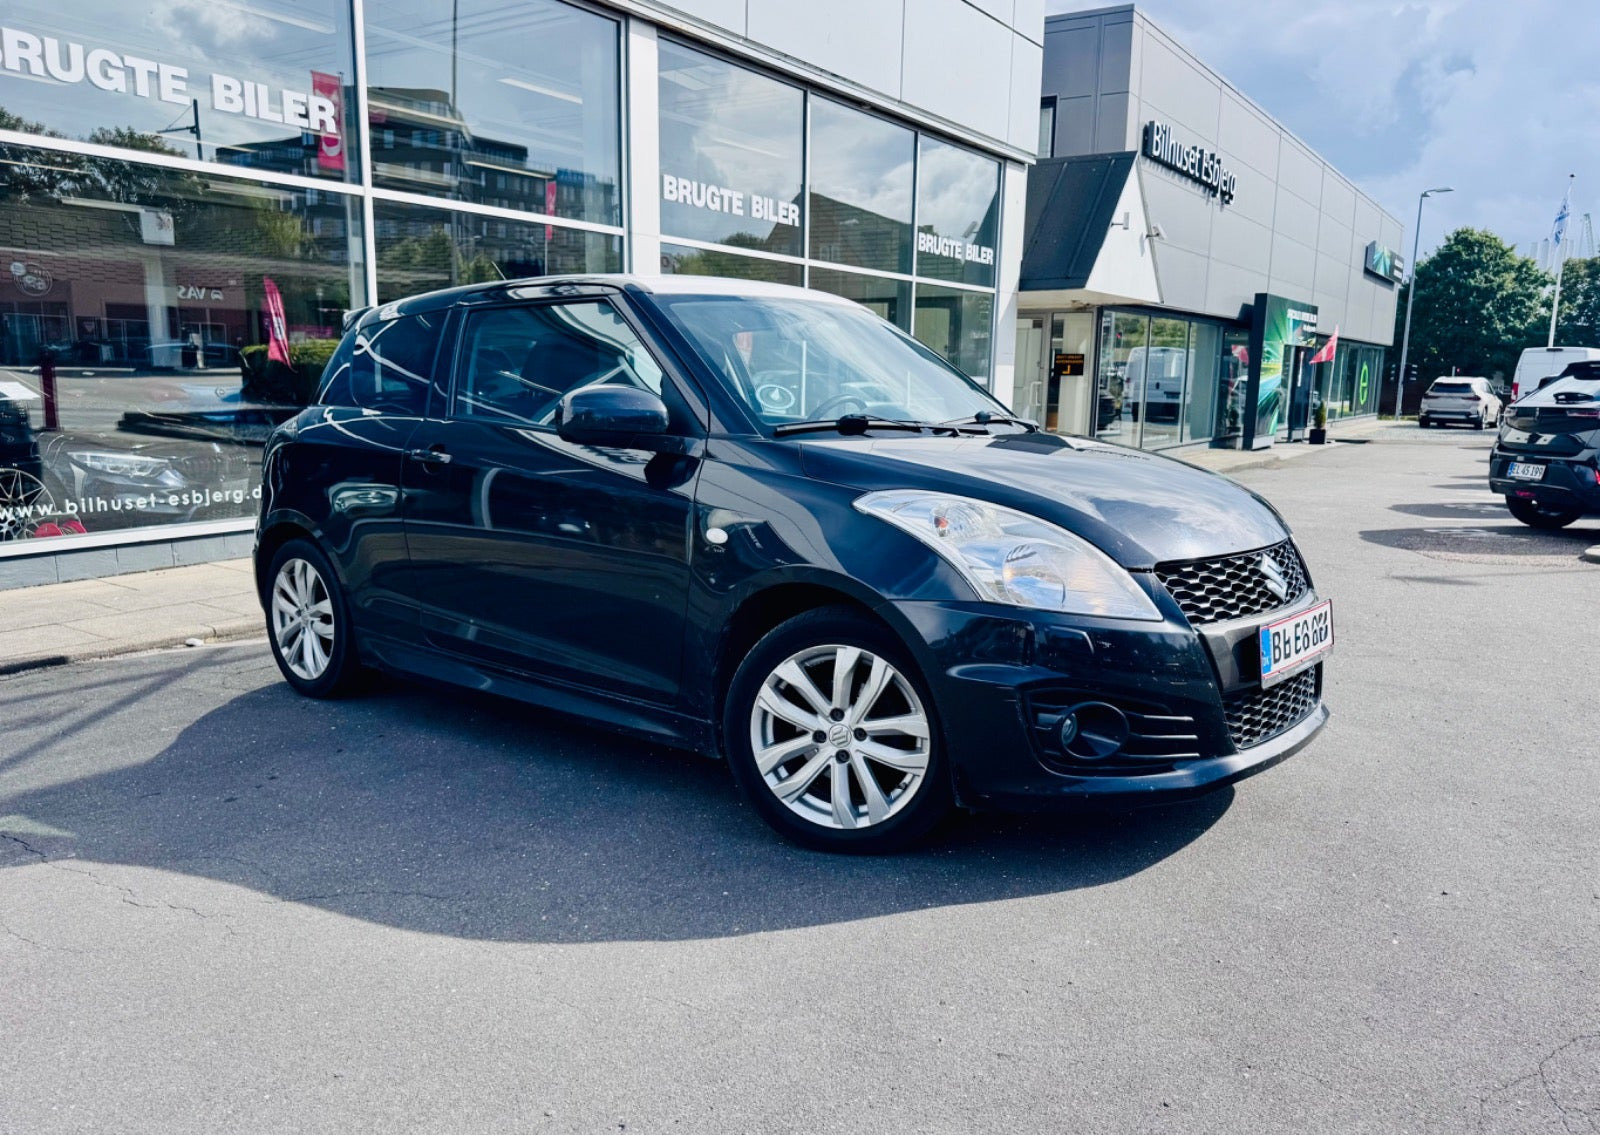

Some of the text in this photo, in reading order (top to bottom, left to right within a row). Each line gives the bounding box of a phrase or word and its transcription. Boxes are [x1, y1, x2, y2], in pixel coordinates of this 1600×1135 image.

[0, 27, 337, 133] RUGTE BILER
[1151, 120, 1237, 204] Bilhuset Esbjerg
[663, 175, 800, 227] BRUGTE BILER
[918, 232, 994, 266] BRUGTE BILER
